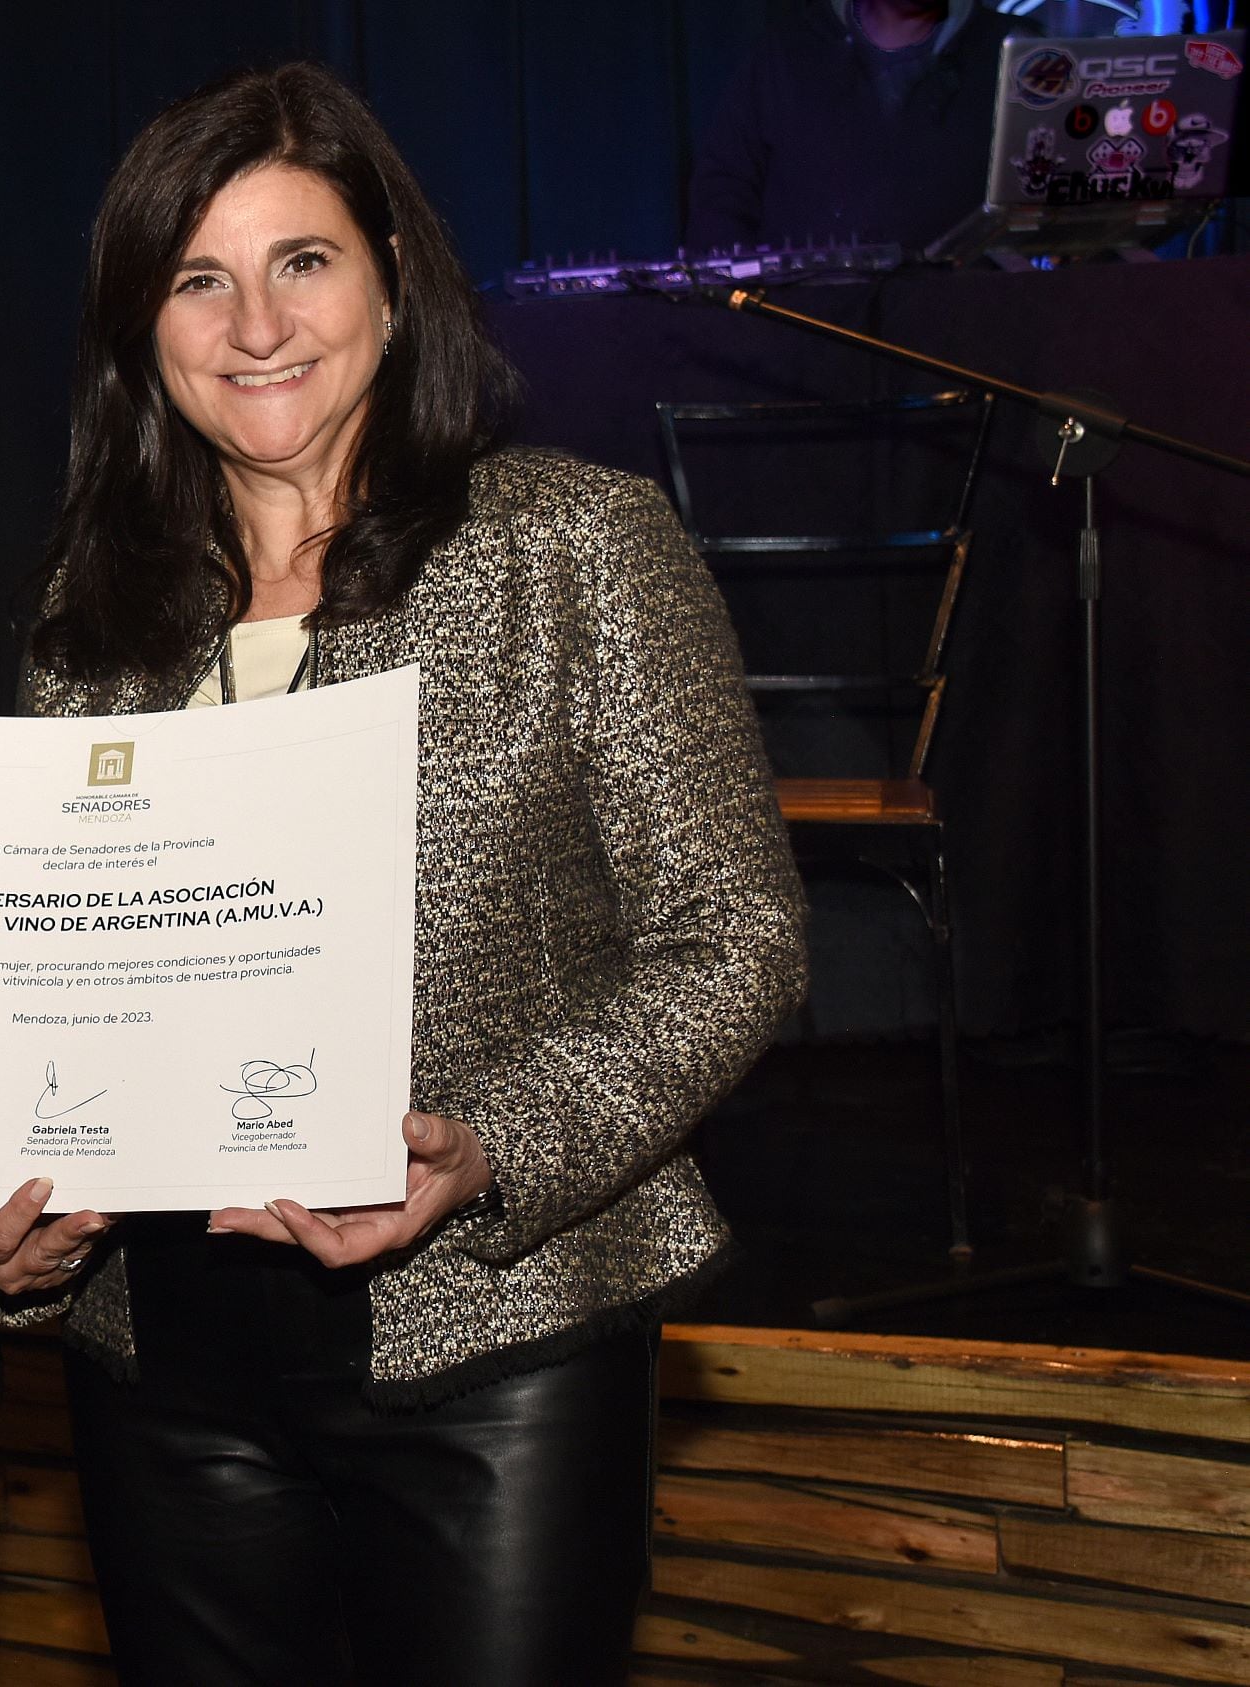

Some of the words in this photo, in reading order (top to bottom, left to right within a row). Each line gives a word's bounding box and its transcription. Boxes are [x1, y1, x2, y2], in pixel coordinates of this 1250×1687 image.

[1079, 54, 1178, 80] QSC
[1086, 80, 1168, 97] Pioneer
[62, 798, 151, 814] SENADORES
[78, 813, 132, 824] MENDOZA
[3, 843, 49, 856] Cámara
[52, 845, 67, 855] de
[69, 843, 131, 855] Senadores
[134, 842, 148, 852] de
[151, 841, 160, 851] la
[163, 837, 215, 850] Provincia
[42, 859, 85, 870] declara
[88, 859, 103, 870] de
[105, 857, 144, 869] interés
[147, 857, 157, 868] el
[86, 892, 113, 907] DE
[118, 891, 144, 907] LA
[148, 877, 275, 905] ASOCIACIÓN
[4, 916, 56, 932] VINO
[60, 916, 88, 931] DE
[92, 910, 211, 931] ARGENTINA
[216, 897, 324, 928] (A.MU.V.A.)
[36, 960, 105, 973] procurando
[108, 958, 154, 972] mejores
[156, 954, 226, 969] condiciones
[229, 955, 236, 965] y
[238, 945, 321, 964] oportunidades
[2, 974, 63, 987] vitivinícola
[66, 978, 73, 989] y
[76, 977, 90, 987] en
[93, 976, 124, 986] otros
[127, 973, 173, 985] ámbitos
[176, 972, 191, 983] de
[194, 969, 238, 982] nuestra
[240, 964, 295, 981] provincia.
[12, 1013, 69, 1026] Mendoza,
[71, 1013, 100, 1026] junio
[103, 1013, 118, 1024] de
[121, 1012, 154, 1024] 2023.
[32, 1125, 77, 1135] Gabriela
[80, 1125, 109, 1135] Testa
[237, 1120, 265, 1130] Mario
[266, 1119, 293, 1129] Abed
[26, 1136, 68, 1145] Senadora
[70, 1136, 112, 1145] Provincial
[231, 1131, 296, 1142] Vicegobernador
[20, 1147, 61, 1156] Provincia
[62, 1148, 74, 1156] de
[76, 1148, 116, 1156] Mendoza
[219, 1144, 256, 1153] Provincia
[257, 1143, 269, 1152] de
[270, 1142, 307, 1151] Mendoza
